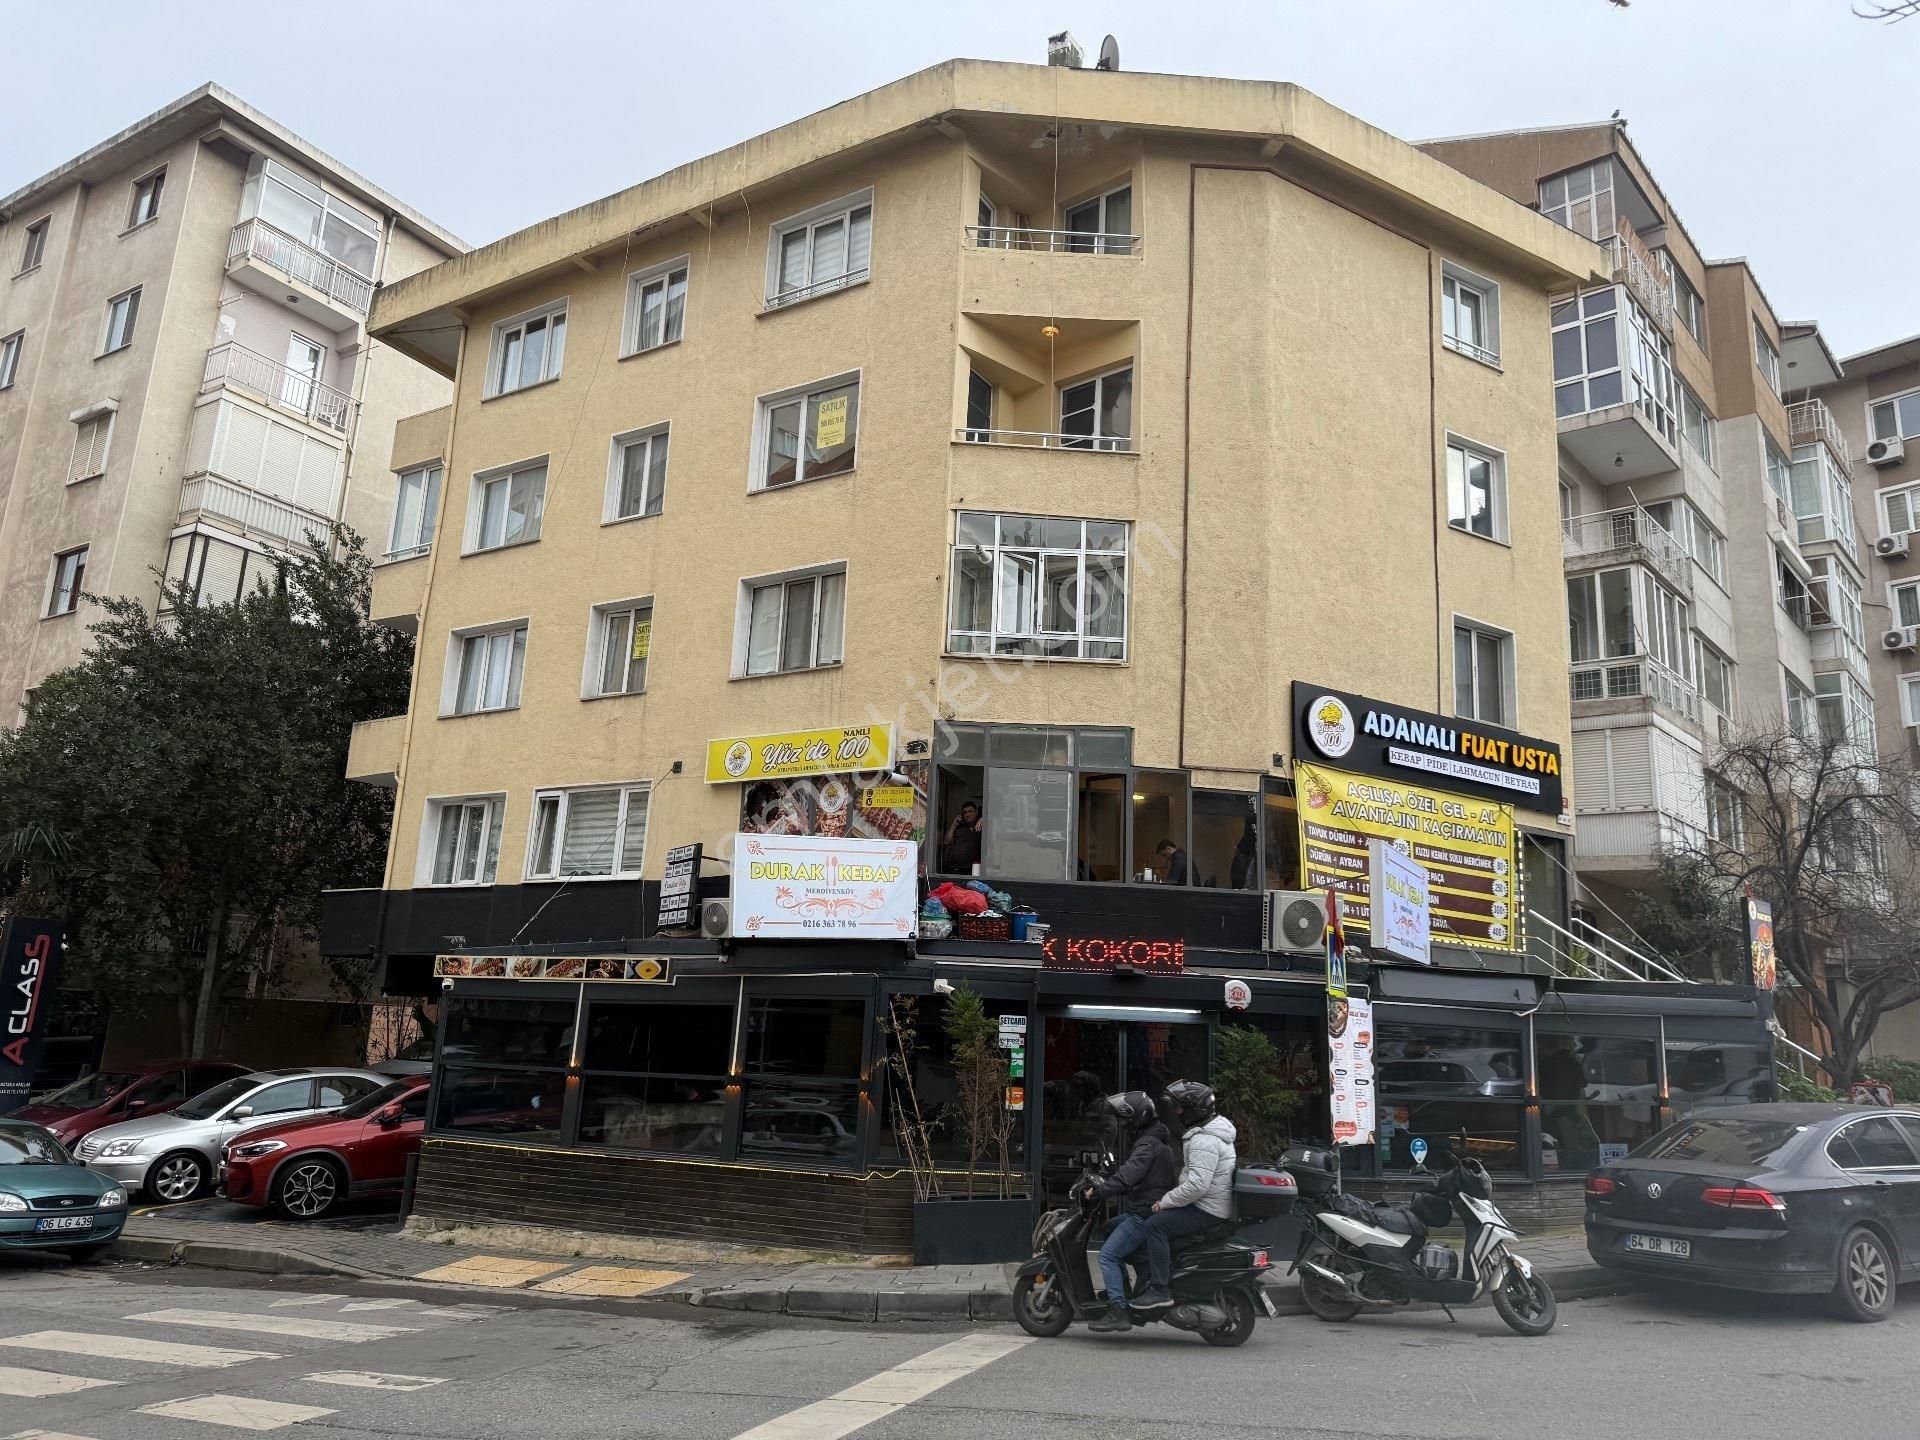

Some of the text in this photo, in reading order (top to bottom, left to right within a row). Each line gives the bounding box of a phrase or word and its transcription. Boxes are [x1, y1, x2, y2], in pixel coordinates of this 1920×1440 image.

[843, 728, 871, 738] NAMLI
[835, 735, 870, 760] 100
[1364, 710, 1456, 752] ADANALI
[1461, 732, 1510, 763] FUAT
[1512, 745, 1559, 776] USTA
[1390, 752, 1539, 792] KEBAP PİDE LAHMACUN BEYRAN
[1347, 781, 1404, 808] AÇILIŞA
[1406, 791, 1438, 814] ÖZEL
[1440, 801, 1468, 820] GEL
[1479, 808, 1496, 825] AL
[1331, 800, 1507, 847] AVANTAJINI KAÇIRMAYIN
[1308, 825, 1328, 839] TAVUK
[1328, 829, 1356, 845] DÜRÜM
[1415, 846, 1430, 858] KUZU
[1339, 856, 1363, 869] AYRAN
[751, 862, 901, 882] DURAK KEBAP
[1430, 872, 1445, 885] PAÇA
[806, 887, 855, 895] MERDİVENKÖY
[802, 920, 820, 928] 0216
[822, 920, 836, 928] 363
[838, 920, 846, 928] 78
[1000, 1016, 1026, 1026] SETCARD
[42, 1216, 92, 1228] 06 LG 439
[1649, 1237, 1662, 1250] DR
[1670, 1240, 1688, 1254] 128
